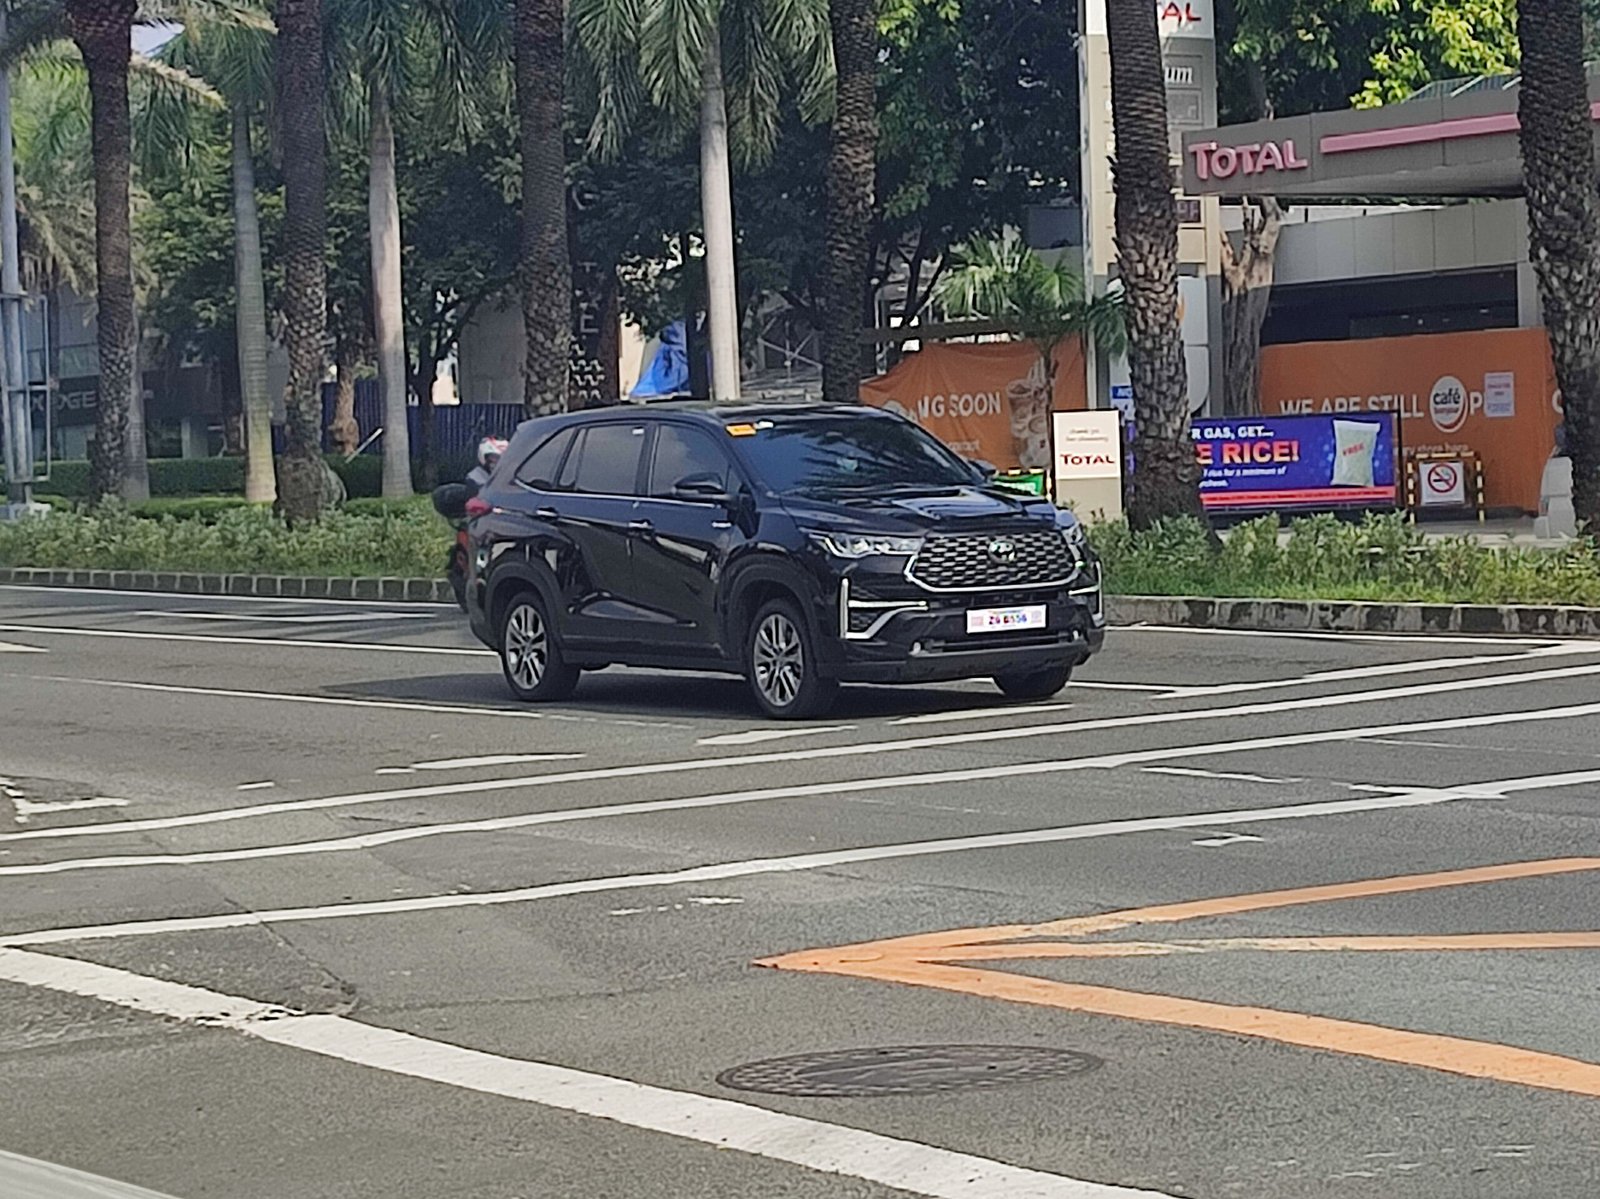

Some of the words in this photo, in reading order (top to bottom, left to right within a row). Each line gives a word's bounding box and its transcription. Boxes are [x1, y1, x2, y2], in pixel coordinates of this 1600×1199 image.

[1160, 2, 1202, 22] AL
[1164, 65, 1193, 84] um
[1188, 140, 1308, 179] TOTAL
[949, 391, 1002, 418] SOON
[1433, 387, 1461, 405] café
[1280, 398, 1314, 415] WE
[1320, 396, 1361, 414] ARE
[1367, 394, 1424, 419] STILL
[1204, 426, 1235, 440] GAS,
[1060, 453, 1115, 465] TOTAL
[1222, 440, 1300, 465] RICE!
